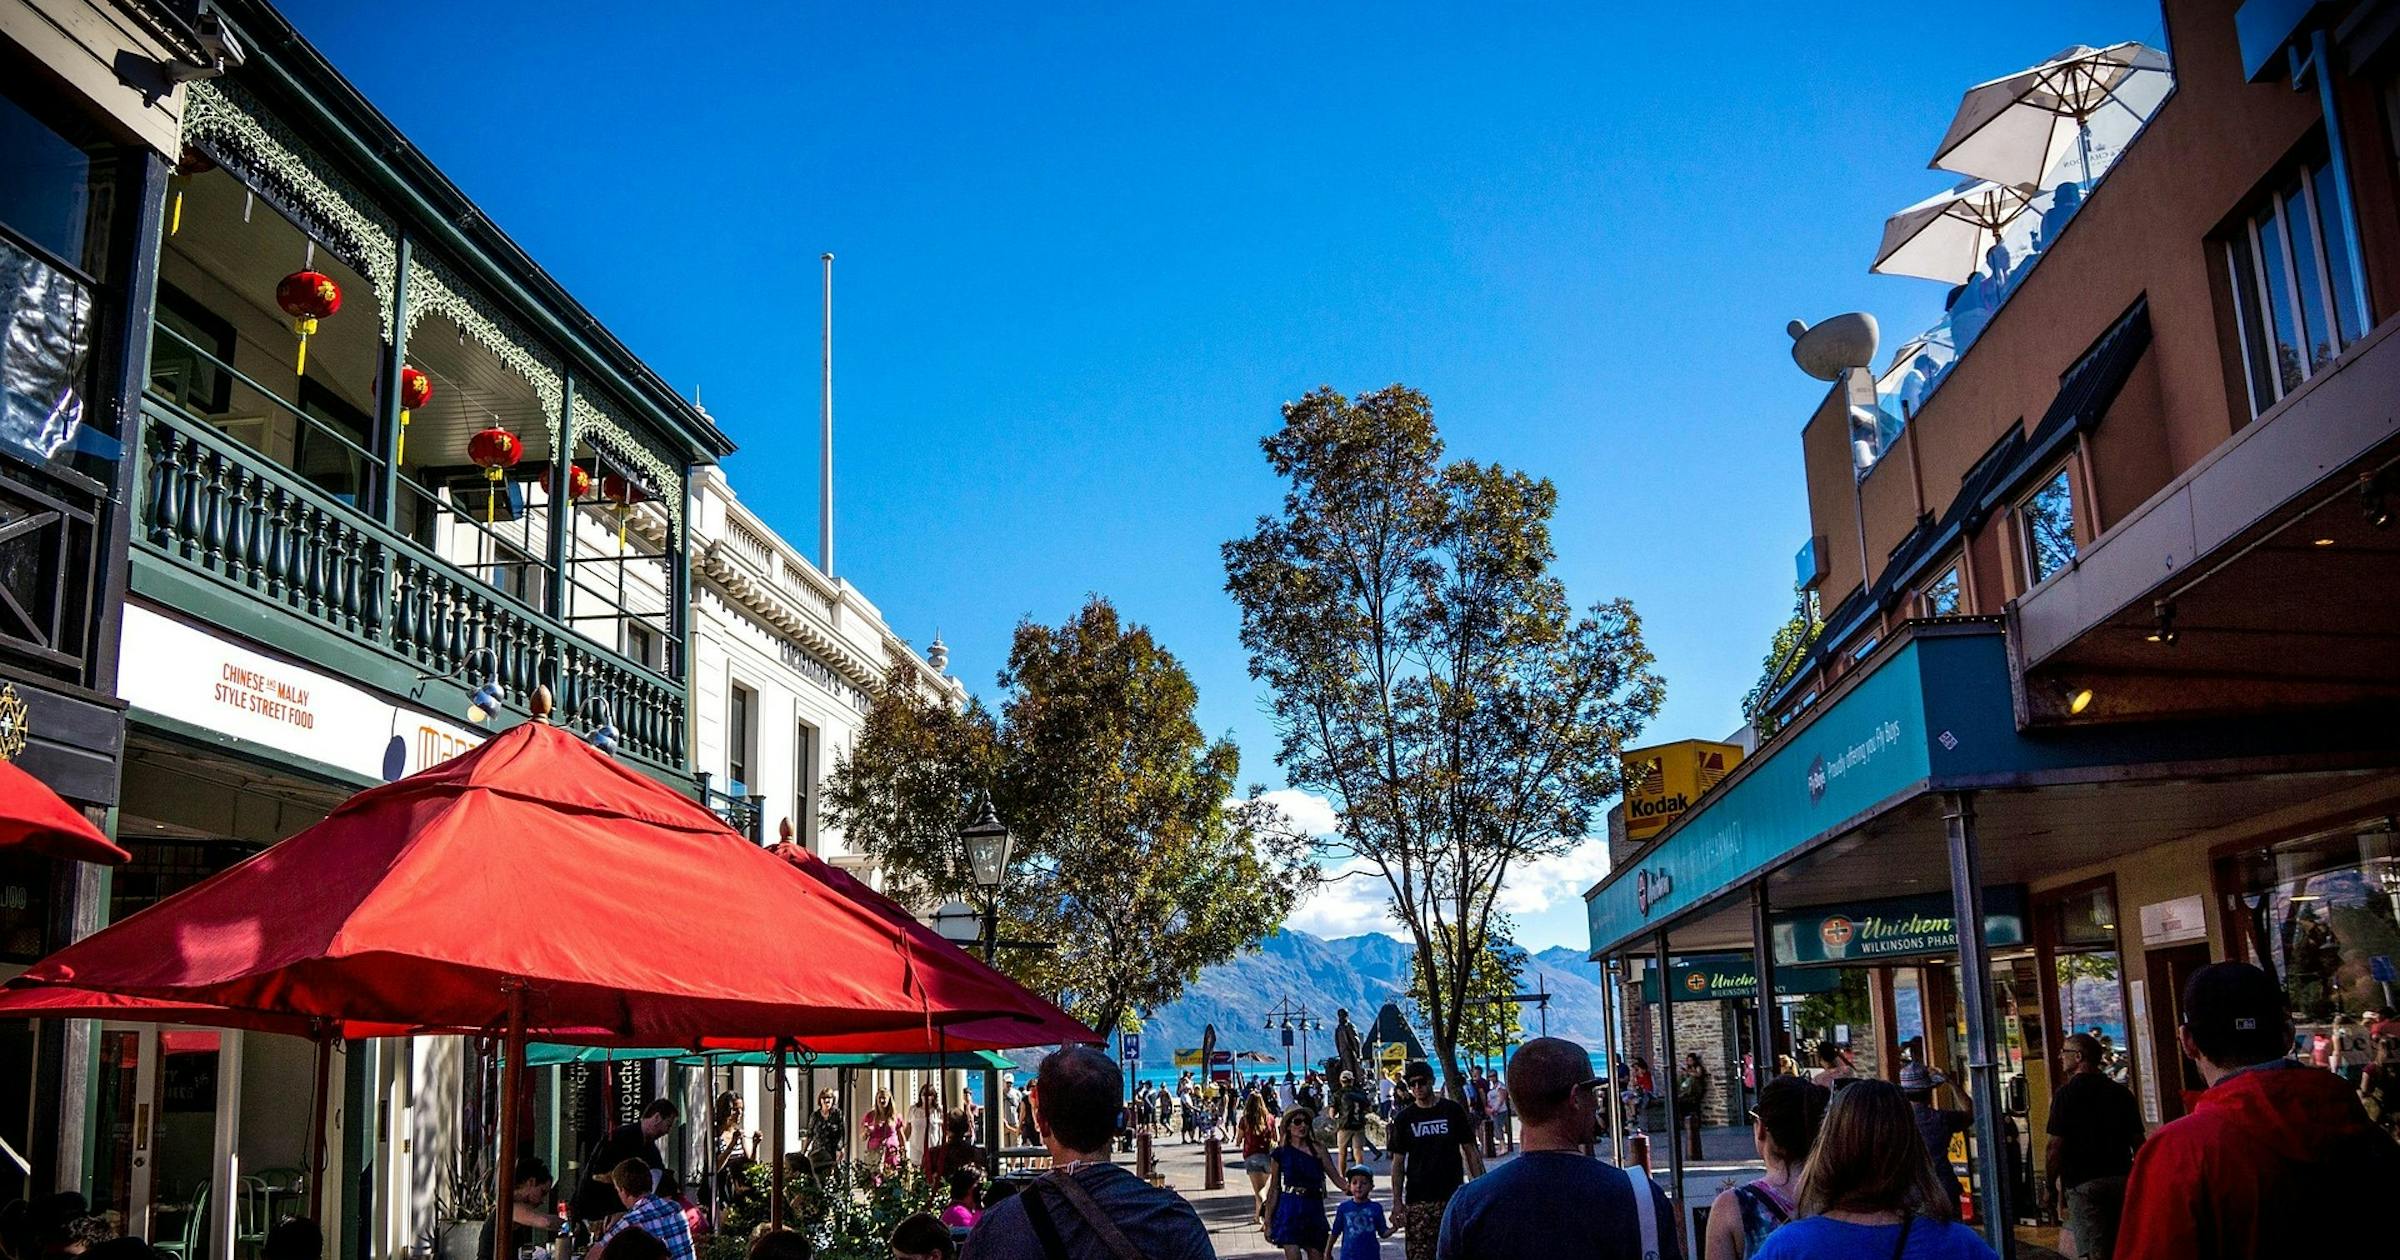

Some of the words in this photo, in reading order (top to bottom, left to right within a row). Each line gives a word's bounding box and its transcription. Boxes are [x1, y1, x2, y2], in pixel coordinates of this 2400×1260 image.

[223, 663, 264, 693] CHINESE
[277, 682, 310, 707] MALAY
[214, 683, 247, 709] STYLE
[249, 695, 287, 721] STREET
[288, 707, 314, 729] FOOD
[1631, 793, 1688, 818] Kodak
[1861, 913, 1952, 940] Unichem
[1861, 937, 1925, 954] WILKINSONS
[1927, 934, 1960, 947] PHAR
[1711, 973, 1758, 988] Uniche
[1711, 986, 1750, 998] WILKINSONS
[633, 1060, 642, 1105] ZEALAND
[1411, 1119, 1449, 1137] VANS
